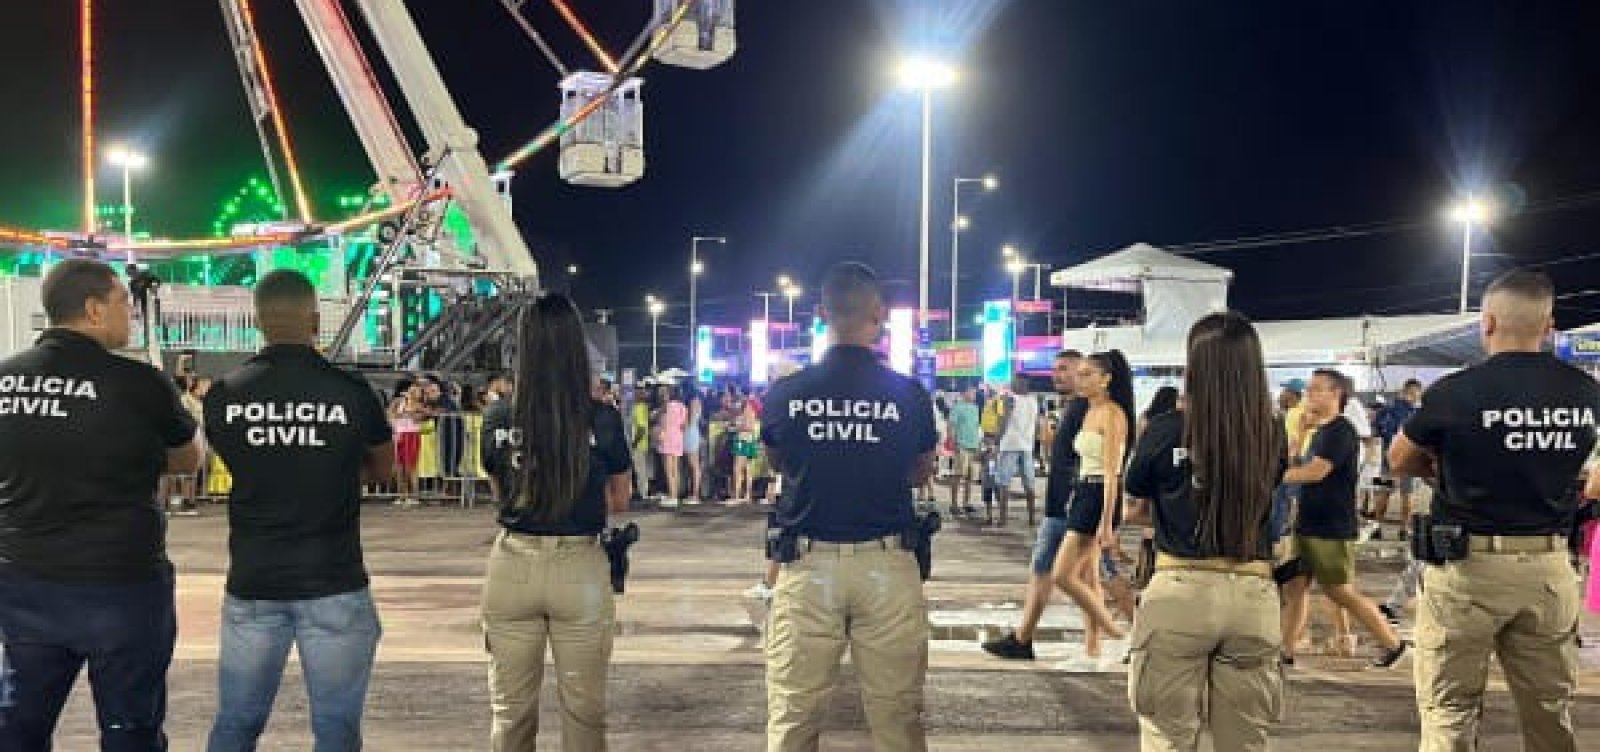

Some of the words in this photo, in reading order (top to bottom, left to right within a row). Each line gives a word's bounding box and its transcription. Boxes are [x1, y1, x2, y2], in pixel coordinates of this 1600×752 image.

[247, 427, 326, 446] CIVIL
[808, 422, 880, 443] CIVIL
[1504, 432, 1577, 451] CIVIL
